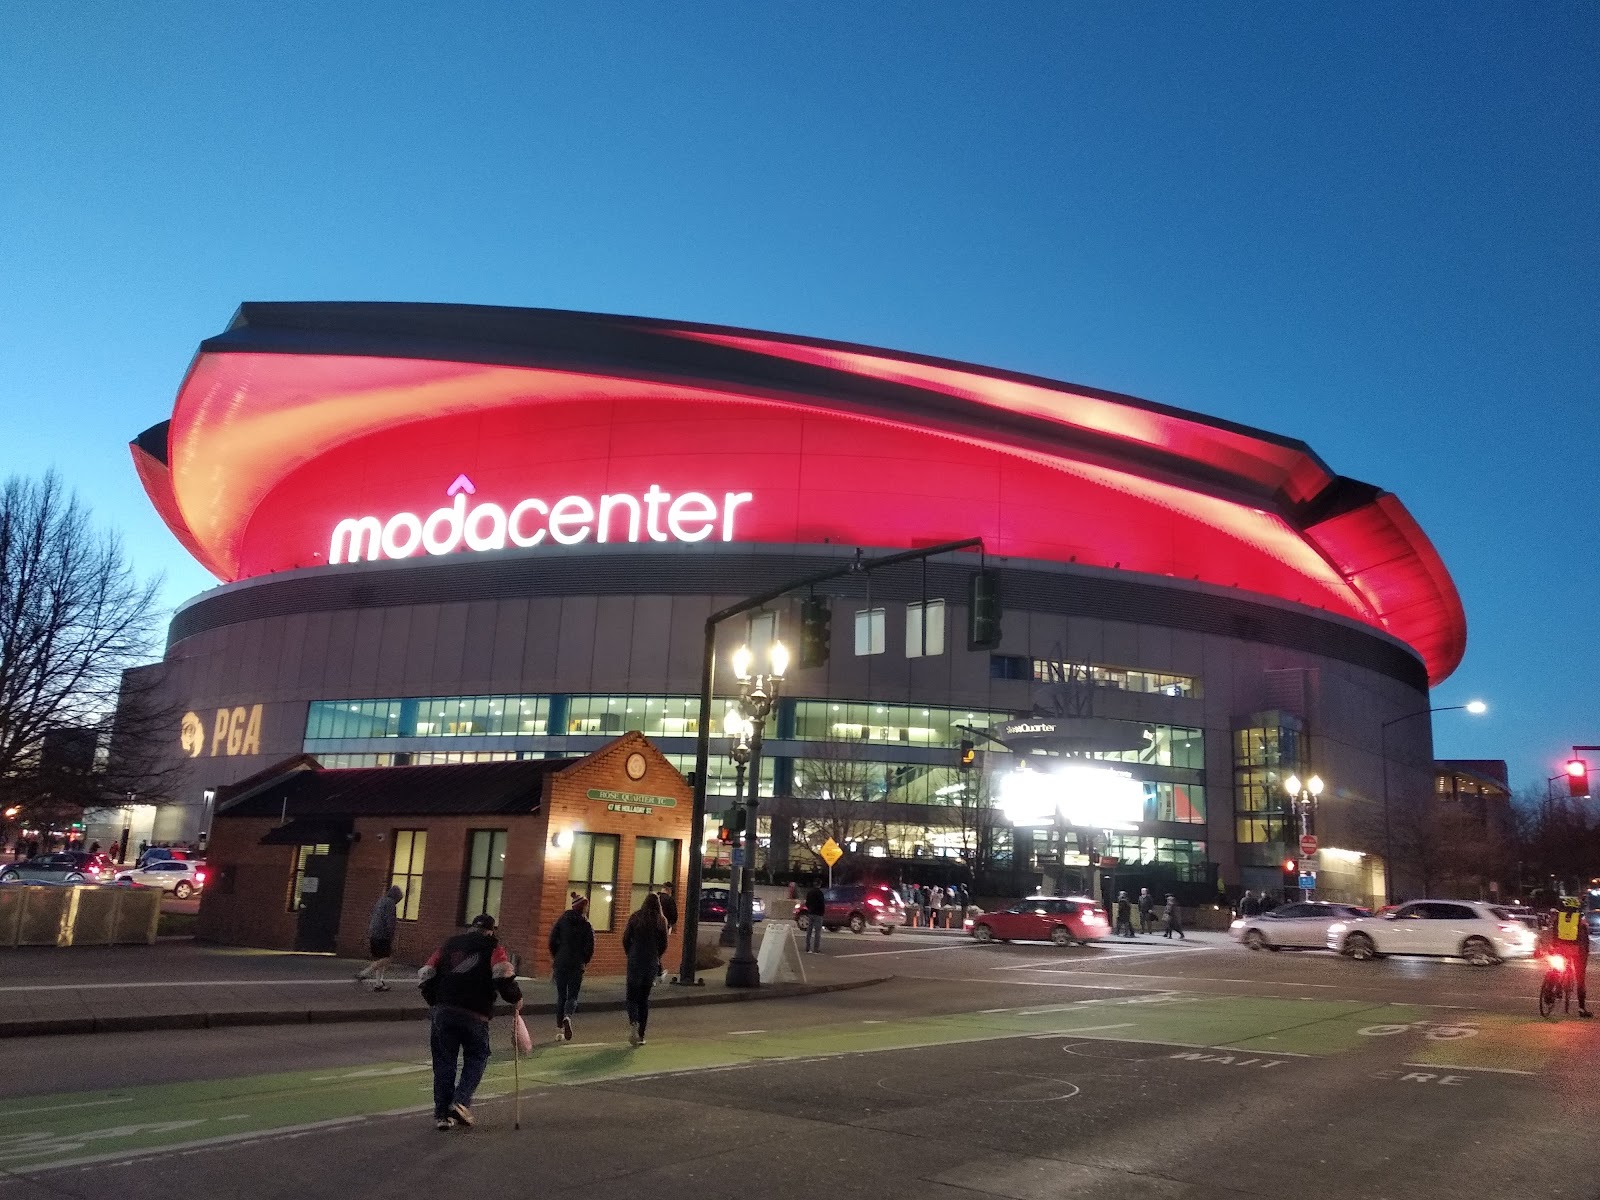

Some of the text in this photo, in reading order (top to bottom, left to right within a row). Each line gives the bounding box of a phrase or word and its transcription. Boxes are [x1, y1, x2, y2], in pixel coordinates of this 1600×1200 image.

[210, 703, 264, 757] PGA
[599, 791, 667, 805] ROSE QUARTER TC
[1169, 1051, 1292, 1069] WAIT
